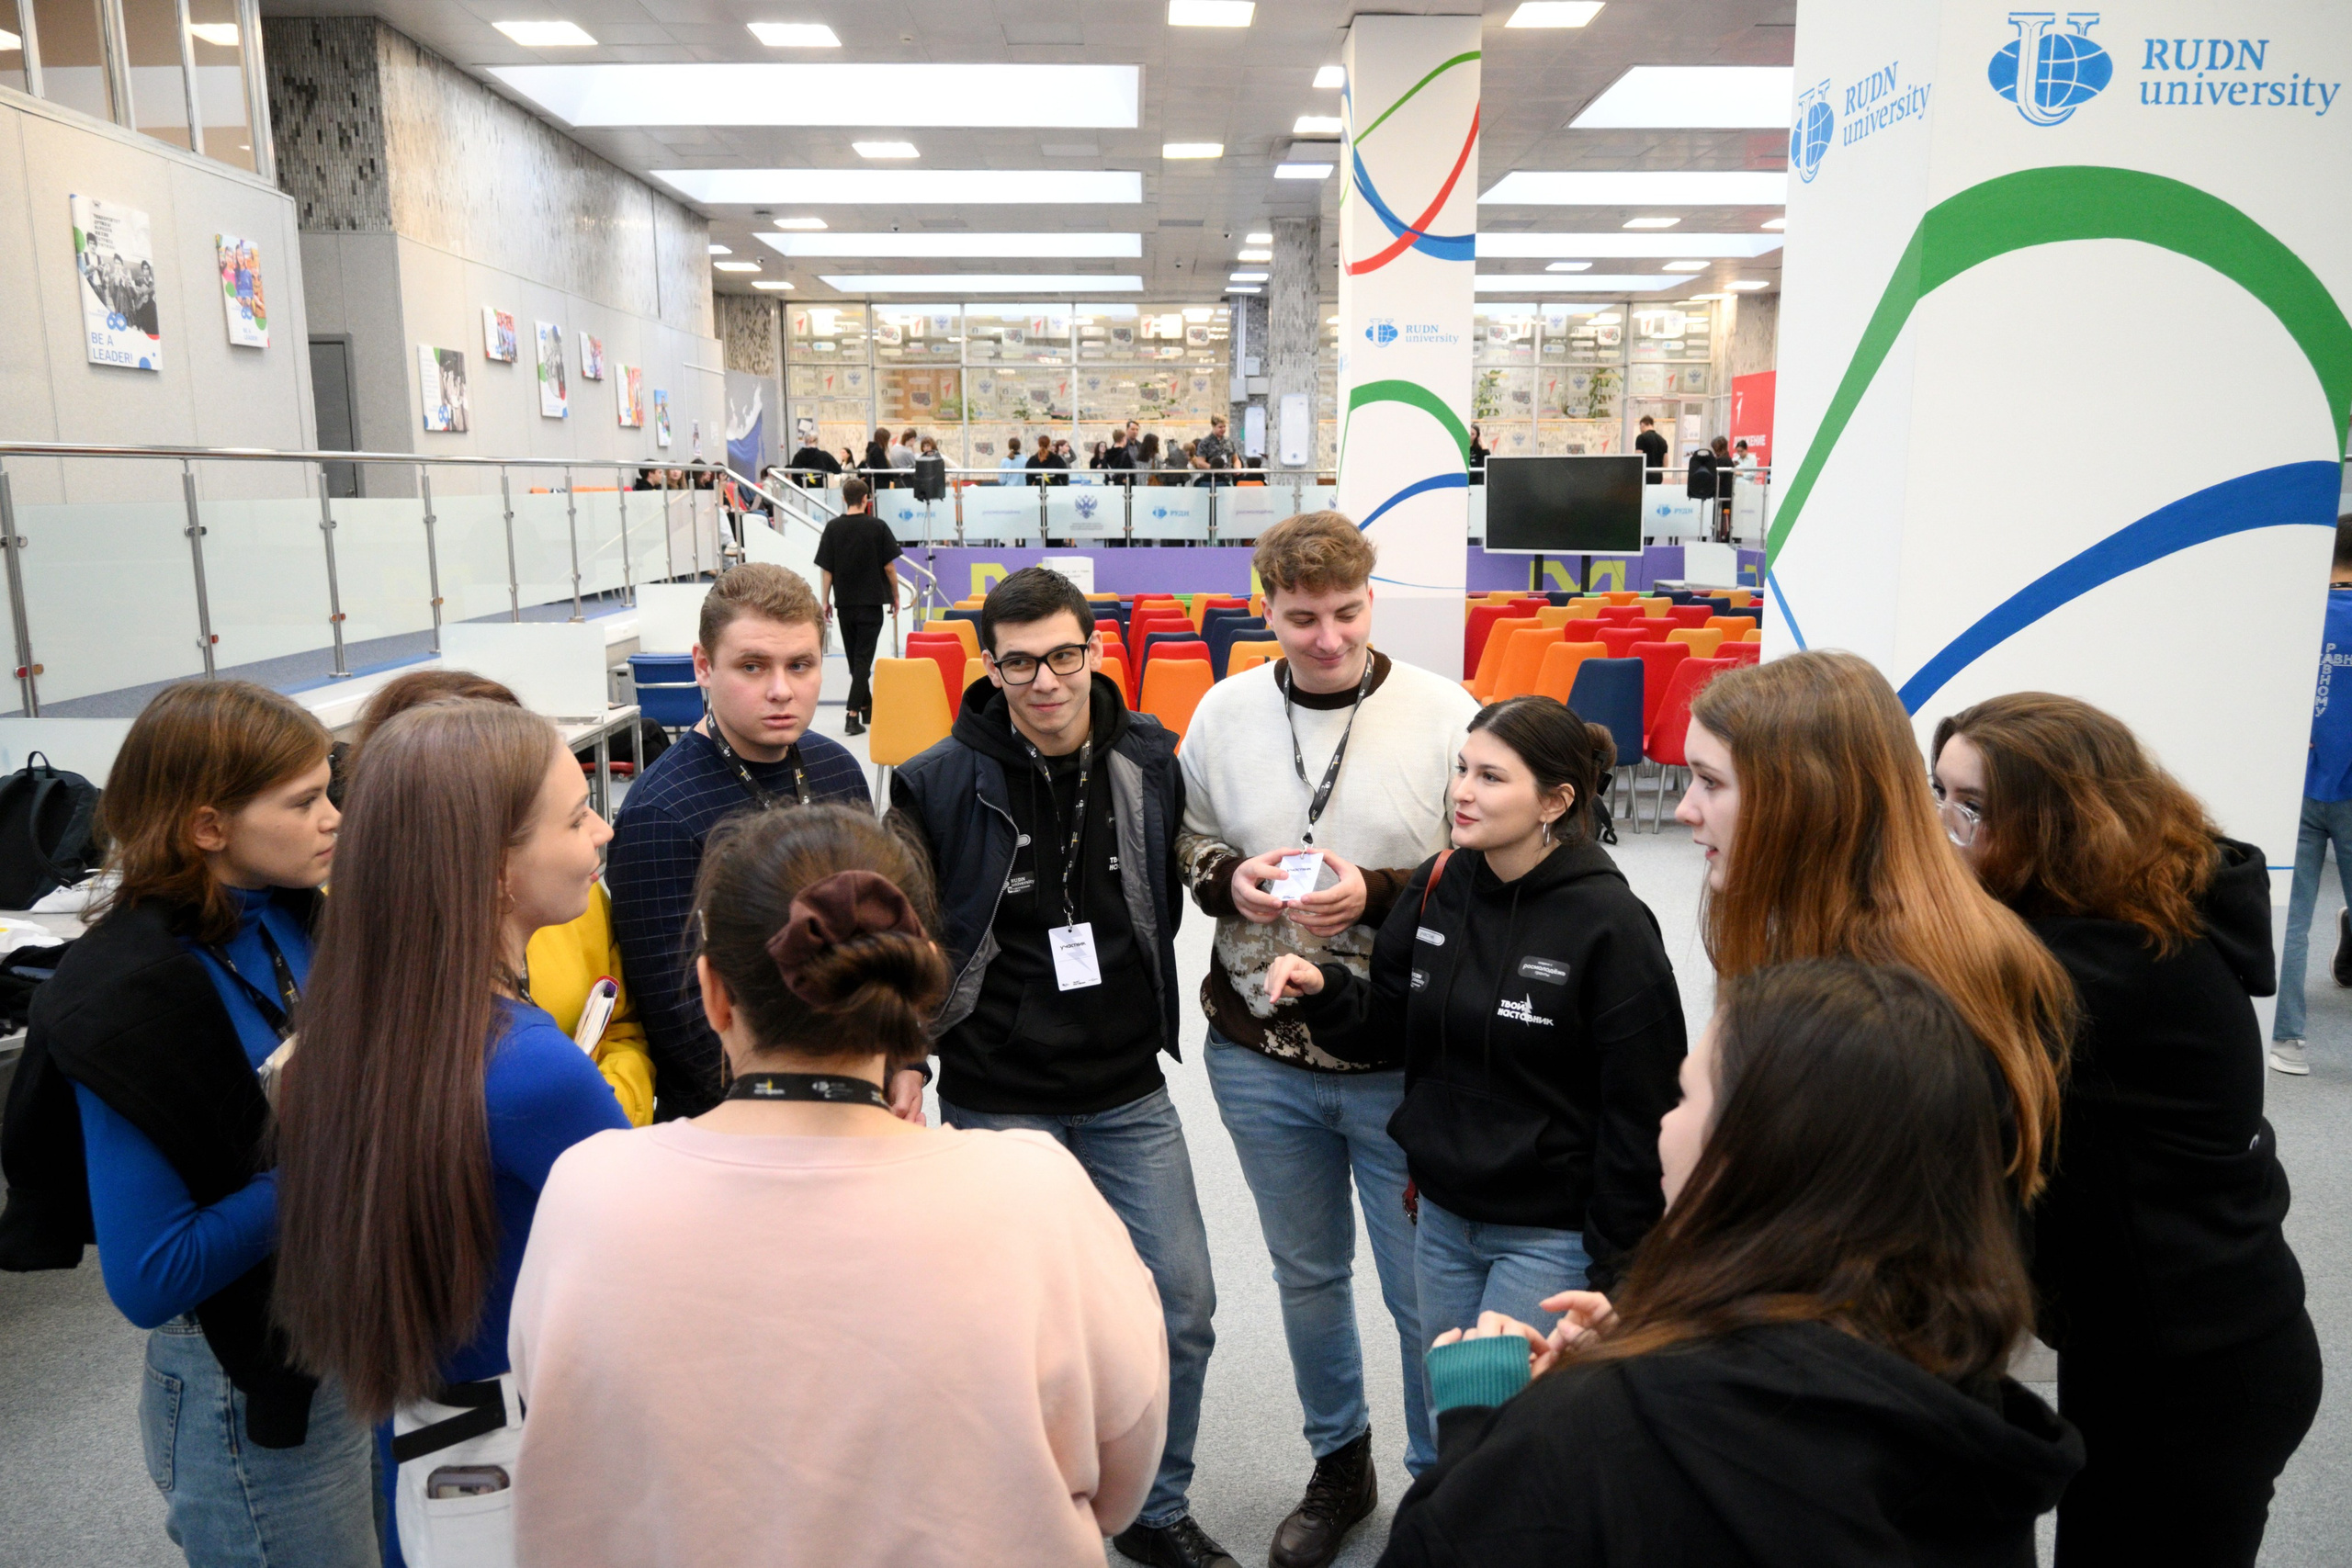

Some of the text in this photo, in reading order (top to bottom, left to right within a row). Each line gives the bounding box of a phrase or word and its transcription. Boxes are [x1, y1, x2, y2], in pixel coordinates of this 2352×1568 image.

[2142, 39, 2270, 71] RUDN
[1844, 61, 1899, 117] RUDN
[2139, 72, 2342, 117] university
[1843, 83, 1931, 147] university
[107, 311, 127, 332] 60
[1406, 324, 1440, 333] RUDN
[91, 332, 114, 346] BE A
[1406, 333, 1460, 344] university
[93, 348, 133, 365] LEADER!
